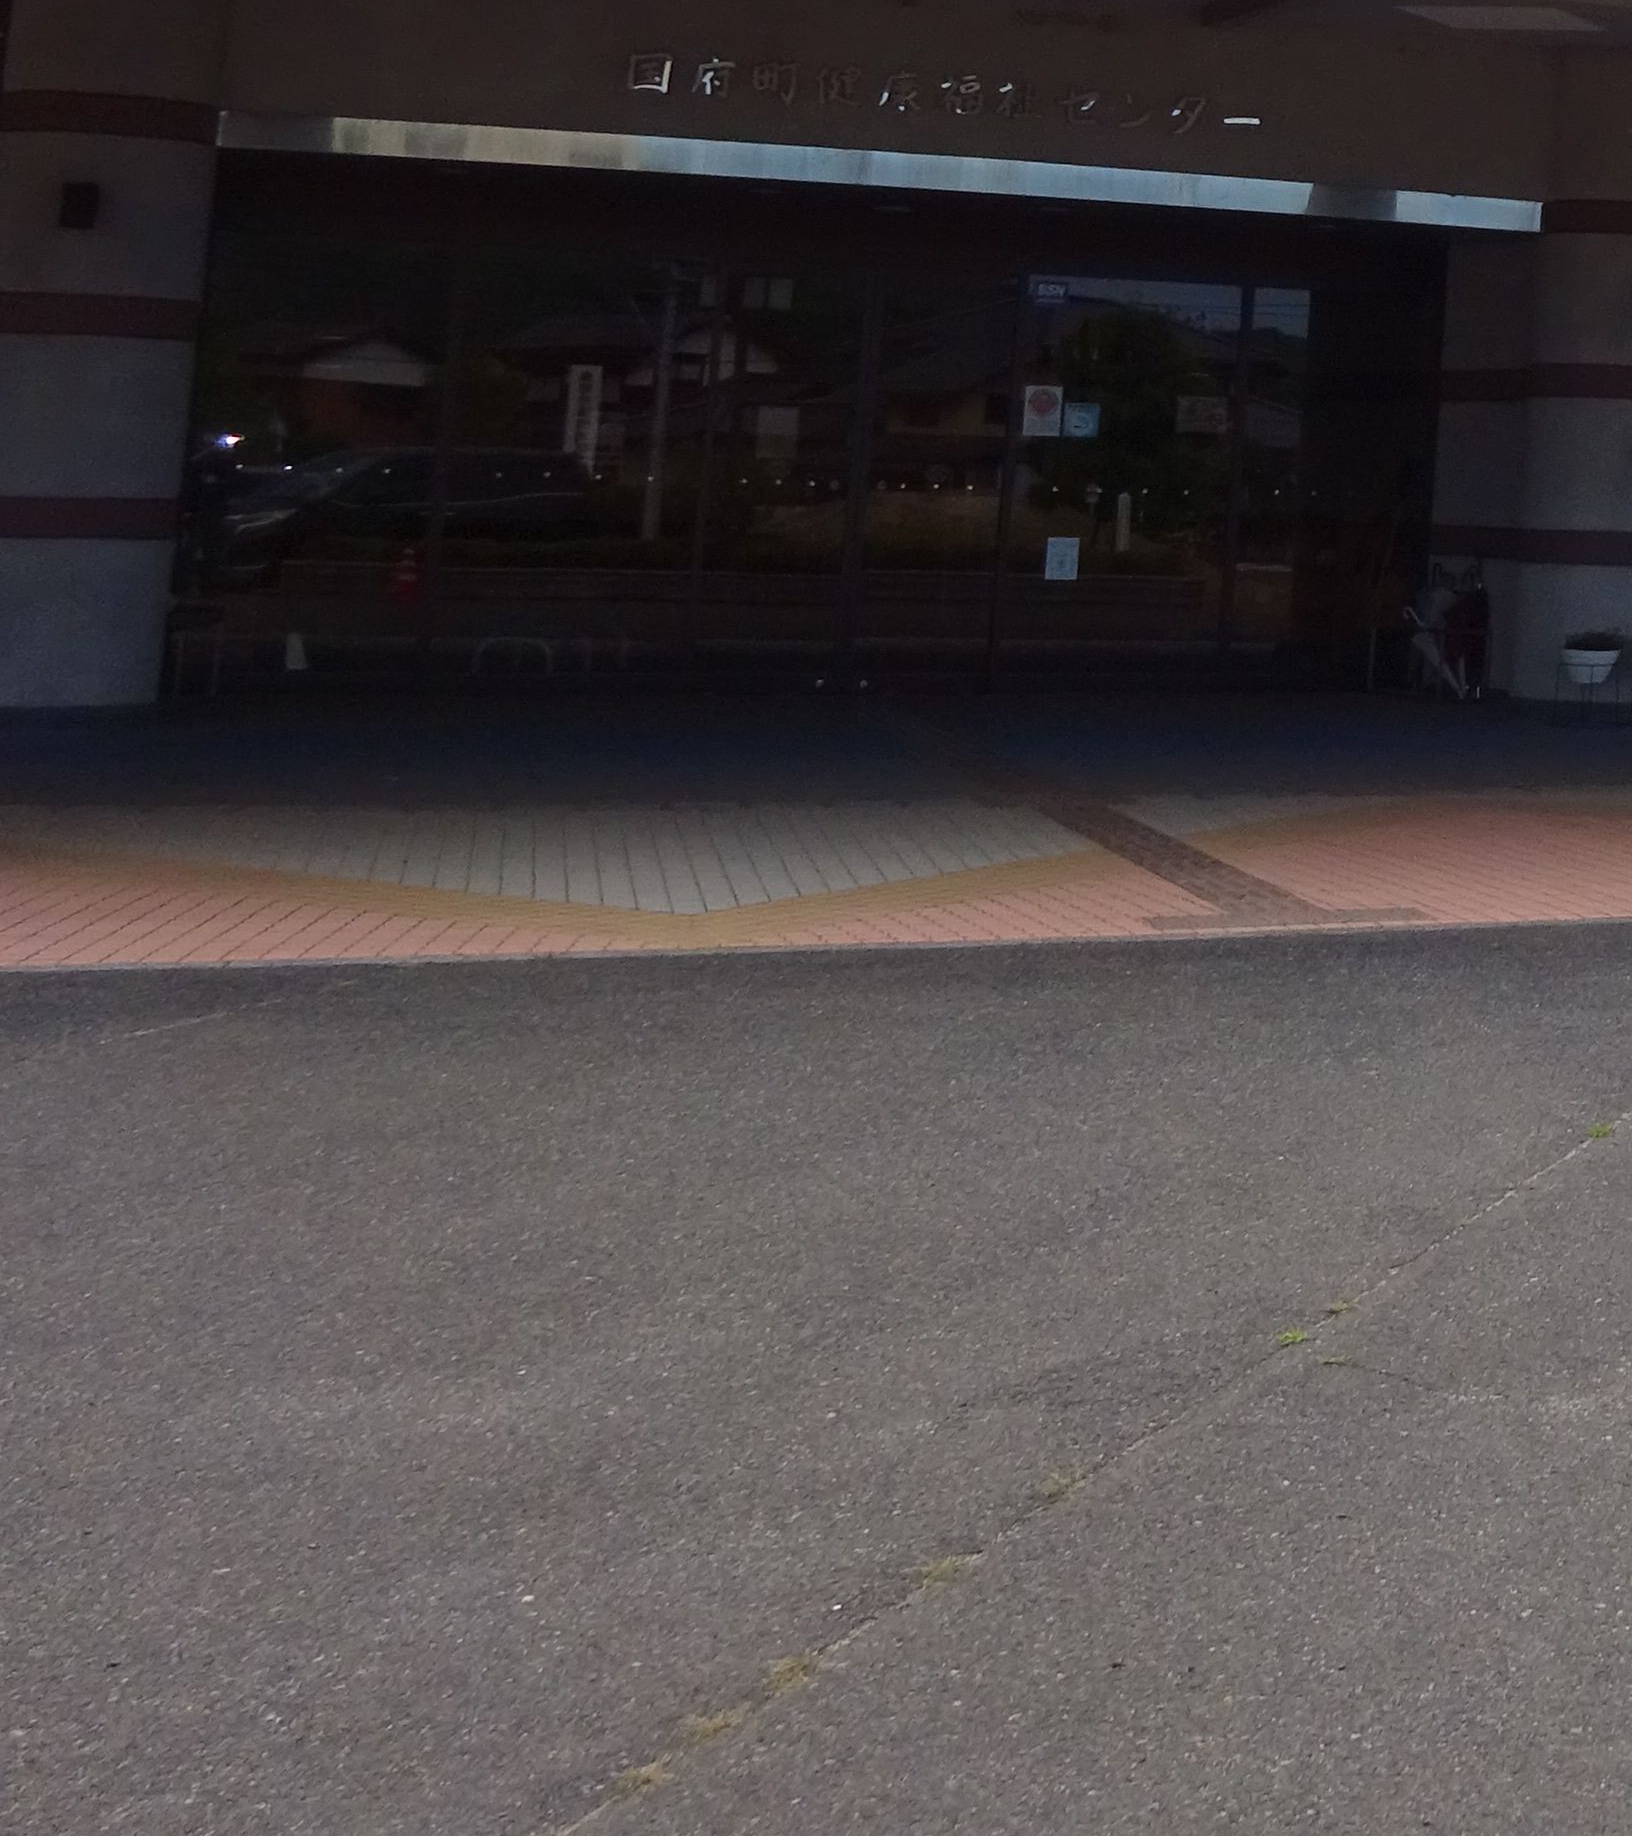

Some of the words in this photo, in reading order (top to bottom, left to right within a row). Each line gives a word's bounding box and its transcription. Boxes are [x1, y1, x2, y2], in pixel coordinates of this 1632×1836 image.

[627, 53, 1262, 135] 国府町健康福祉センター
